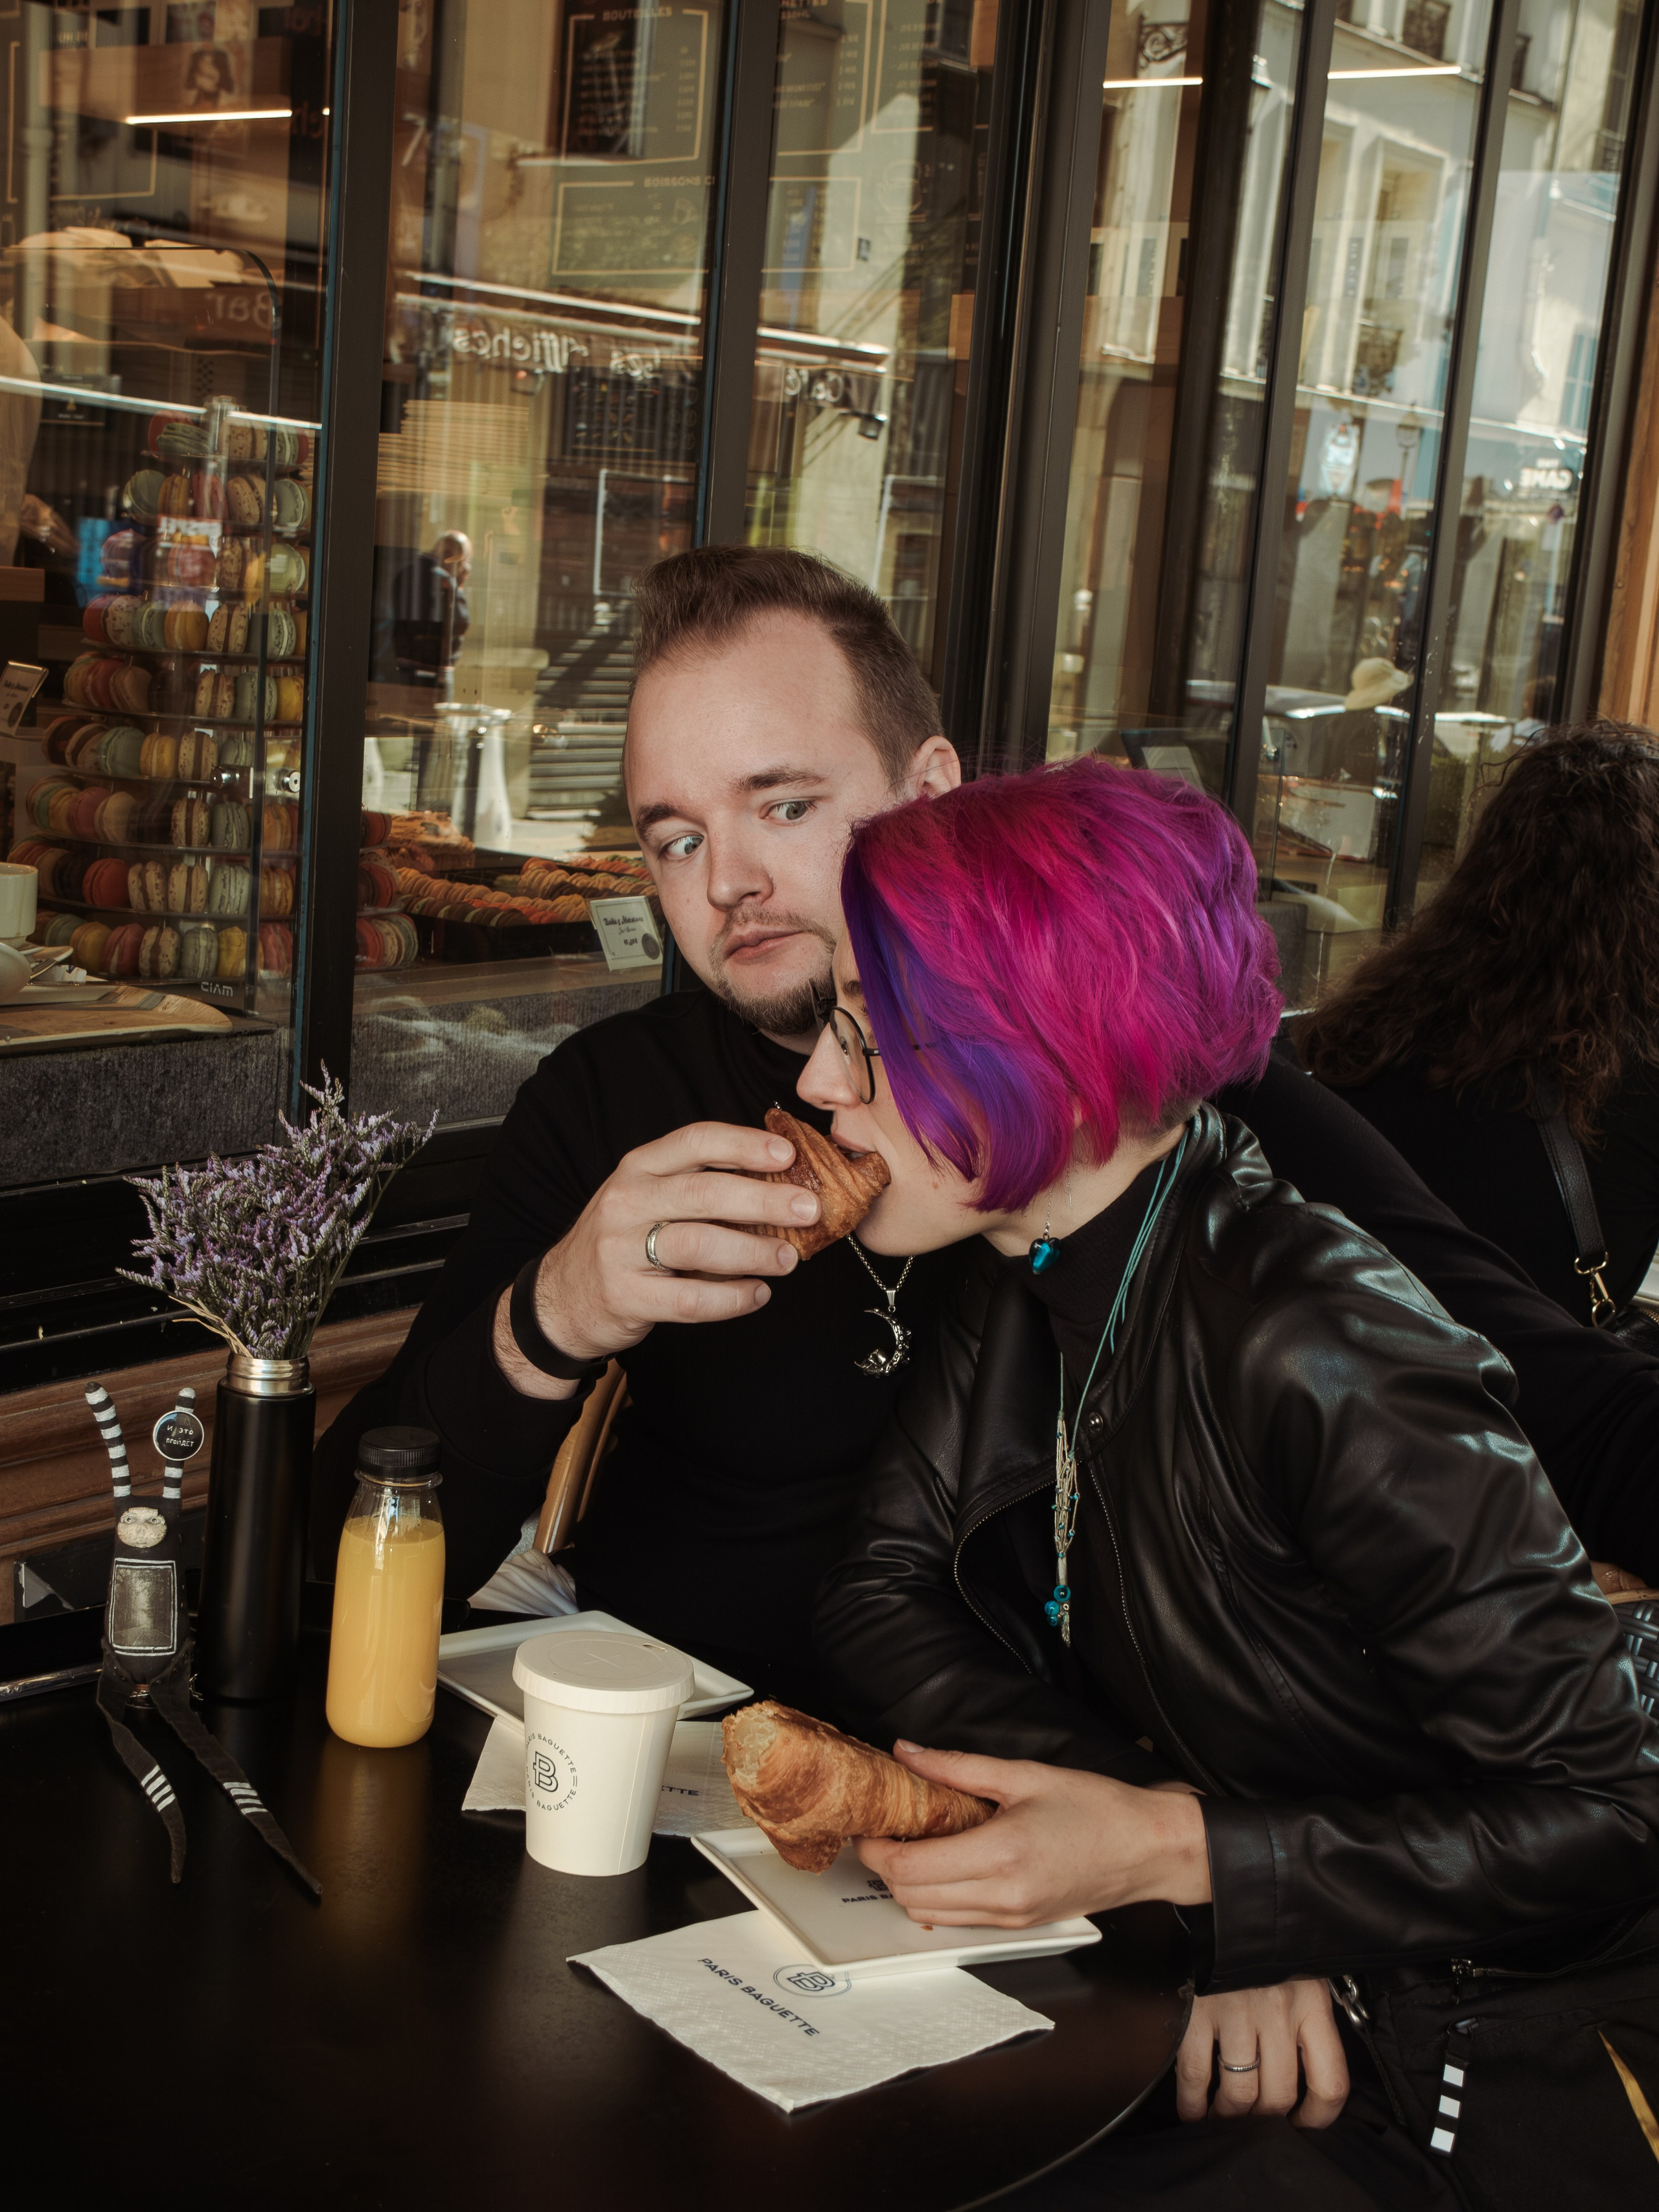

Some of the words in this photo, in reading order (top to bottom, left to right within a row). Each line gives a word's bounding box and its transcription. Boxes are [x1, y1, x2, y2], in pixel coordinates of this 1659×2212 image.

[200, 981, 233, 997] CIAM
[538, 1733, 577, 1773] BAGUETTE
[537, 1789, 577, 1811] BAGUETTE
[697, 1958, 743, 1986] PARIS
[740, 1985, 820, 2037] BAGUETTE
